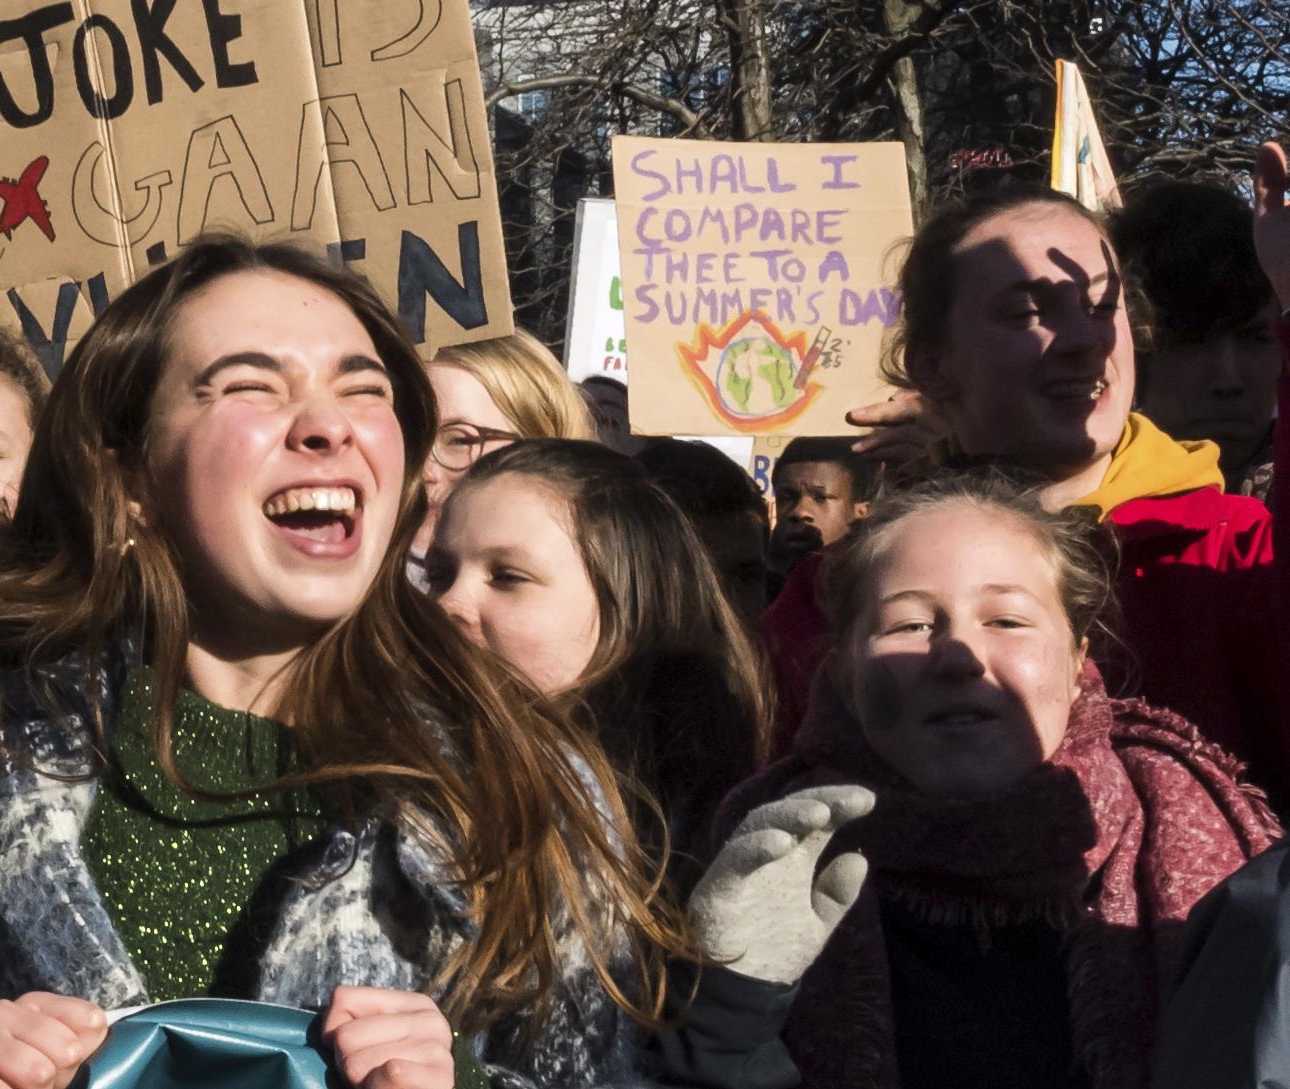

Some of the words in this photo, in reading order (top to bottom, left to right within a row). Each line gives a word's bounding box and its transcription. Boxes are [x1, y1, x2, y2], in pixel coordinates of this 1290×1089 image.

[71, 78, 481, 247] GAAN
[631, 149, 797, 202] SHALL
[821, 155, 861, 190] I
[636, 202, 849, 245] COMPARE
[633, 246, 747, 284] THEE
[749, 248, 807, 283] TO
[818, 250, 850, 283] A
[633, 283, 826, 326] SUMMER'S
